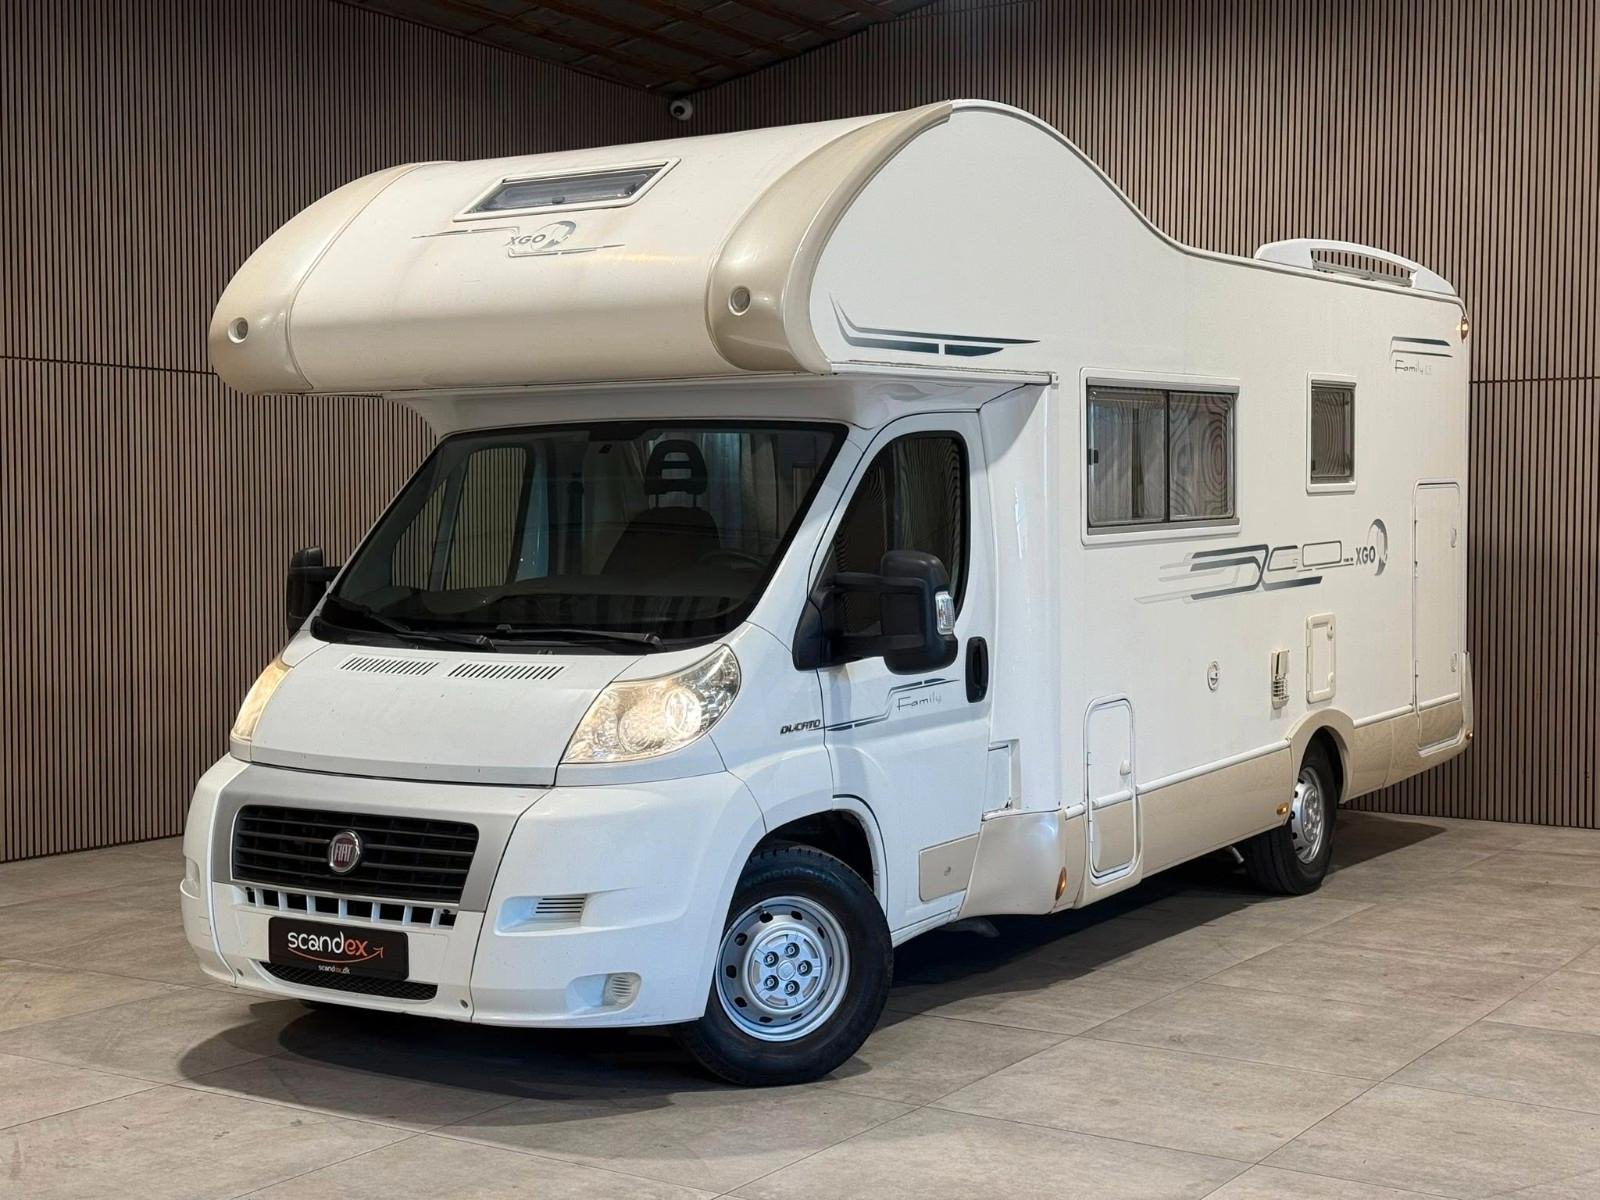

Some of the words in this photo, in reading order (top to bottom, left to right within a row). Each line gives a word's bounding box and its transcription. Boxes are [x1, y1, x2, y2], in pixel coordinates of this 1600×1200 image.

[503, 234, 546, 246] XGO
[1355, 545, 1376, 565] XGO
[896, 691, 943, 711] Family
[780, 718, 821, 734] DUCATO
[335, 842, 353, 862] FIAT
[287, 931, 368, 956] scandex
